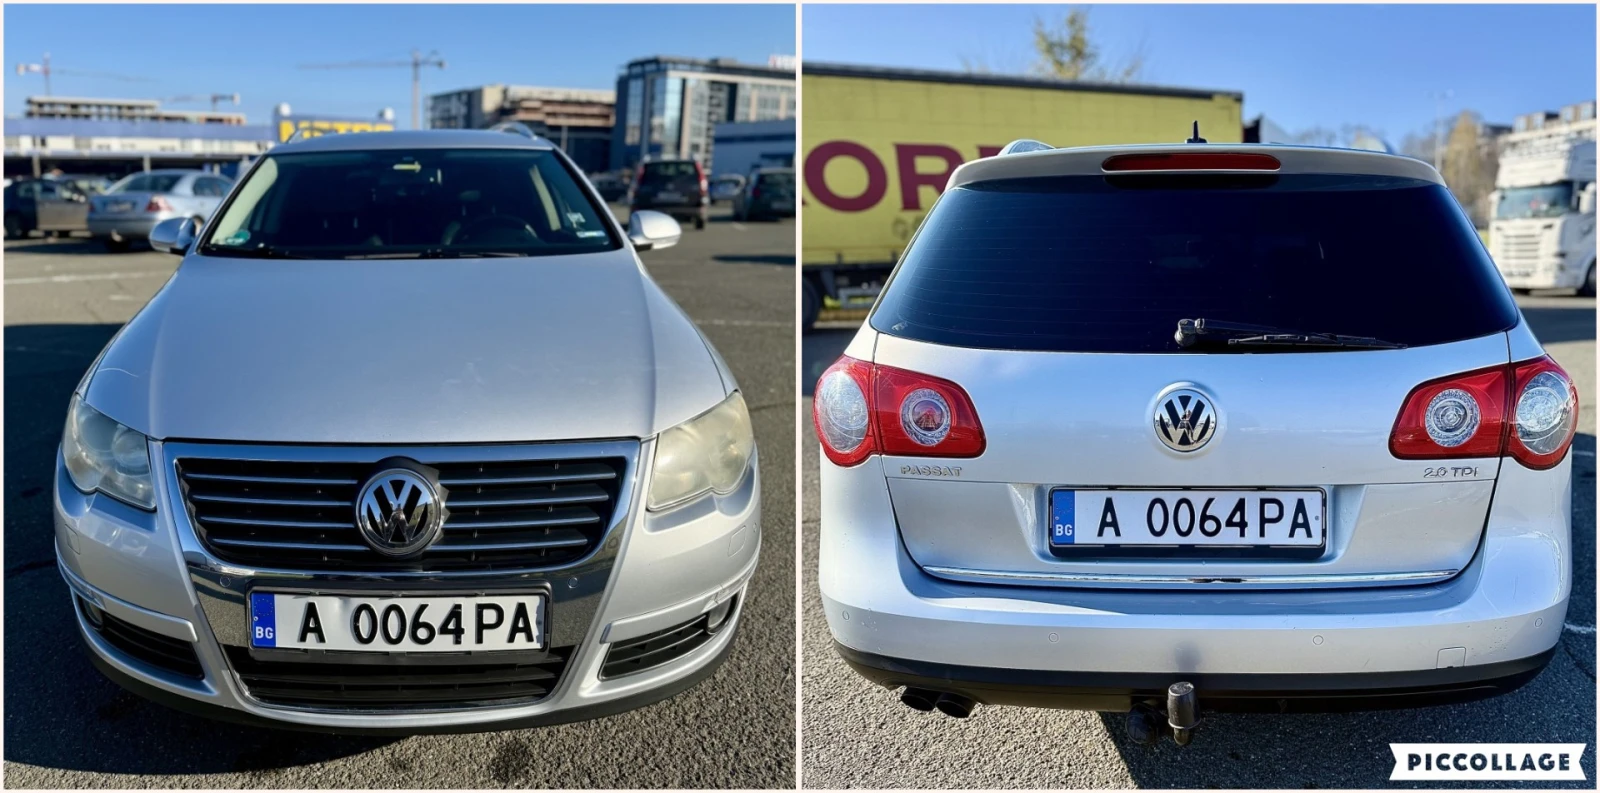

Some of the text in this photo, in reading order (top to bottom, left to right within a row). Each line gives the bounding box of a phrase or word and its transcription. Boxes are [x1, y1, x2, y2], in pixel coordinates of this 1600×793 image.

[901, 464, 962, 477] PASSAT
[1451, 466, 1478, 477] TDI
[1055, 524, 1073, 536] BG
[255, 626, 274, 640] BG
